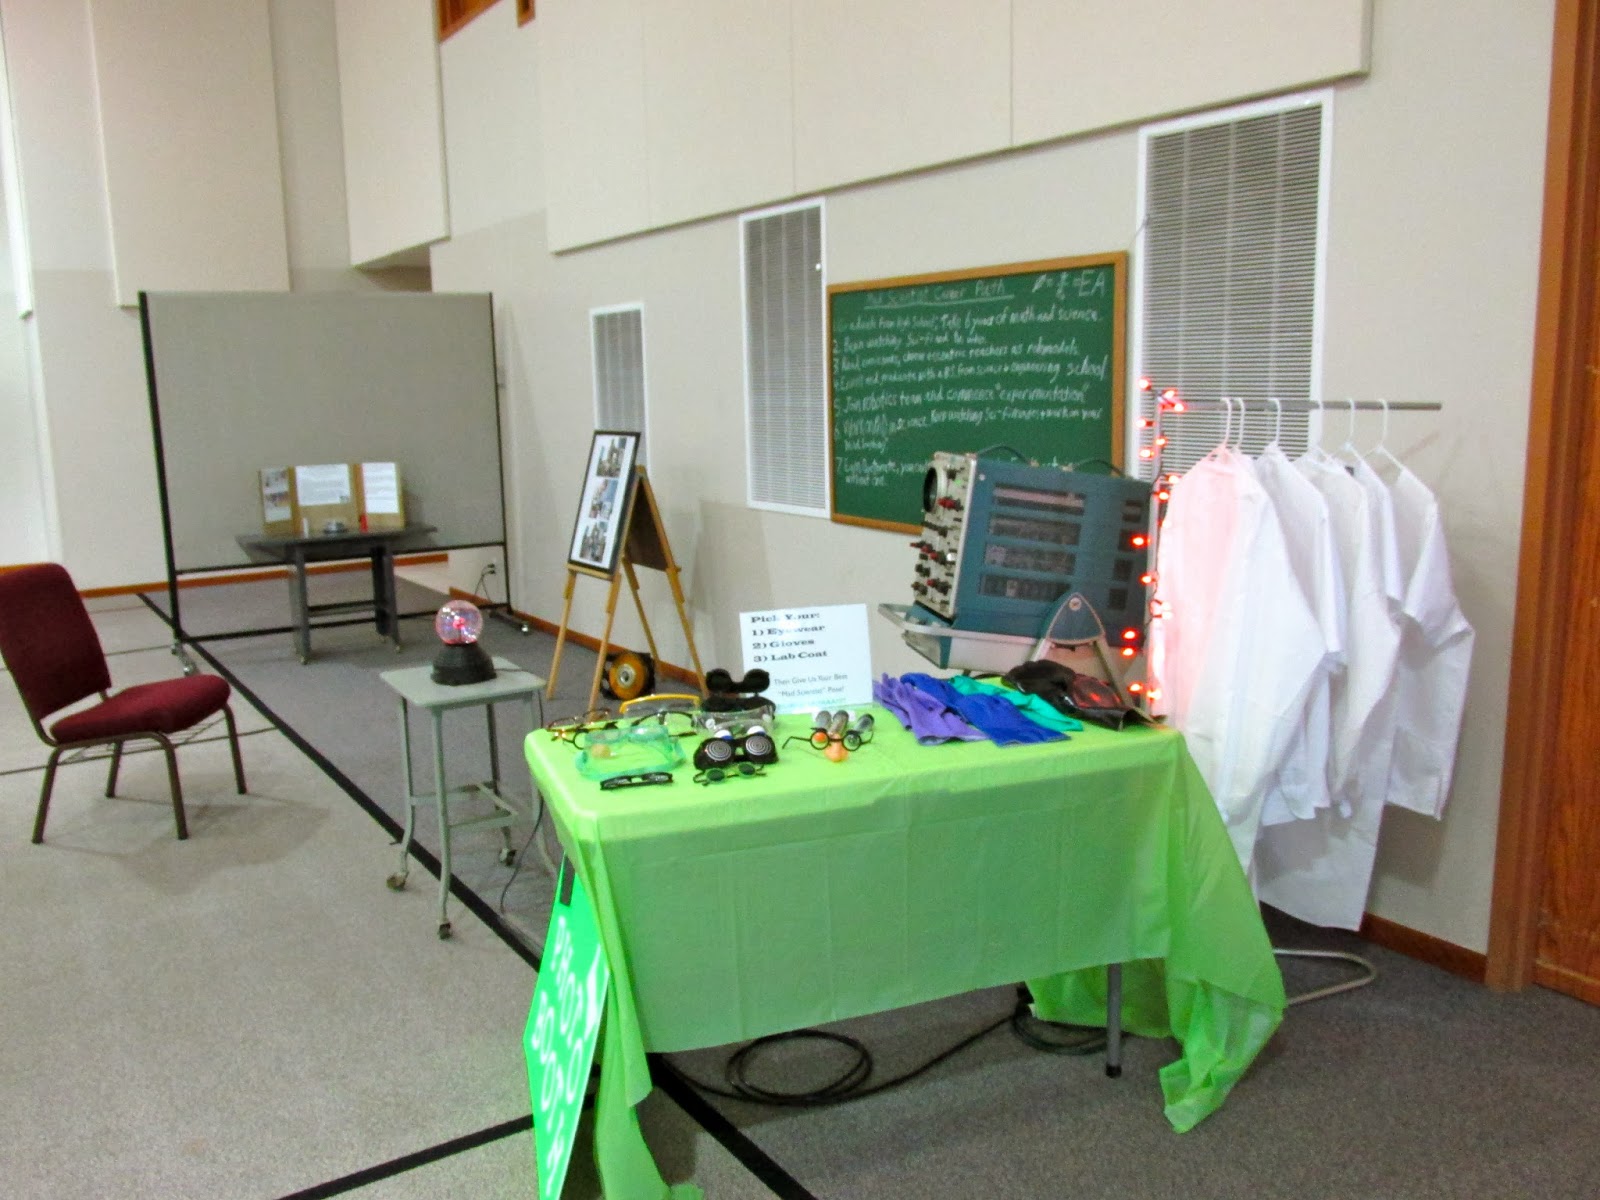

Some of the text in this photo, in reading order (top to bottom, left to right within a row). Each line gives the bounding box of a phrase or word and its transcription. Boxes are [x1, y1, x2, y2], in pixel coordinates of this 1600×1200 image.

[785, 612, 820, 620] Yur:
[767, 625, 825, 636] Eywear
[771, 652, 796, 662] Lab
[798, 649, 828, 660] Coat
[791, 676, 806, 685] Give
